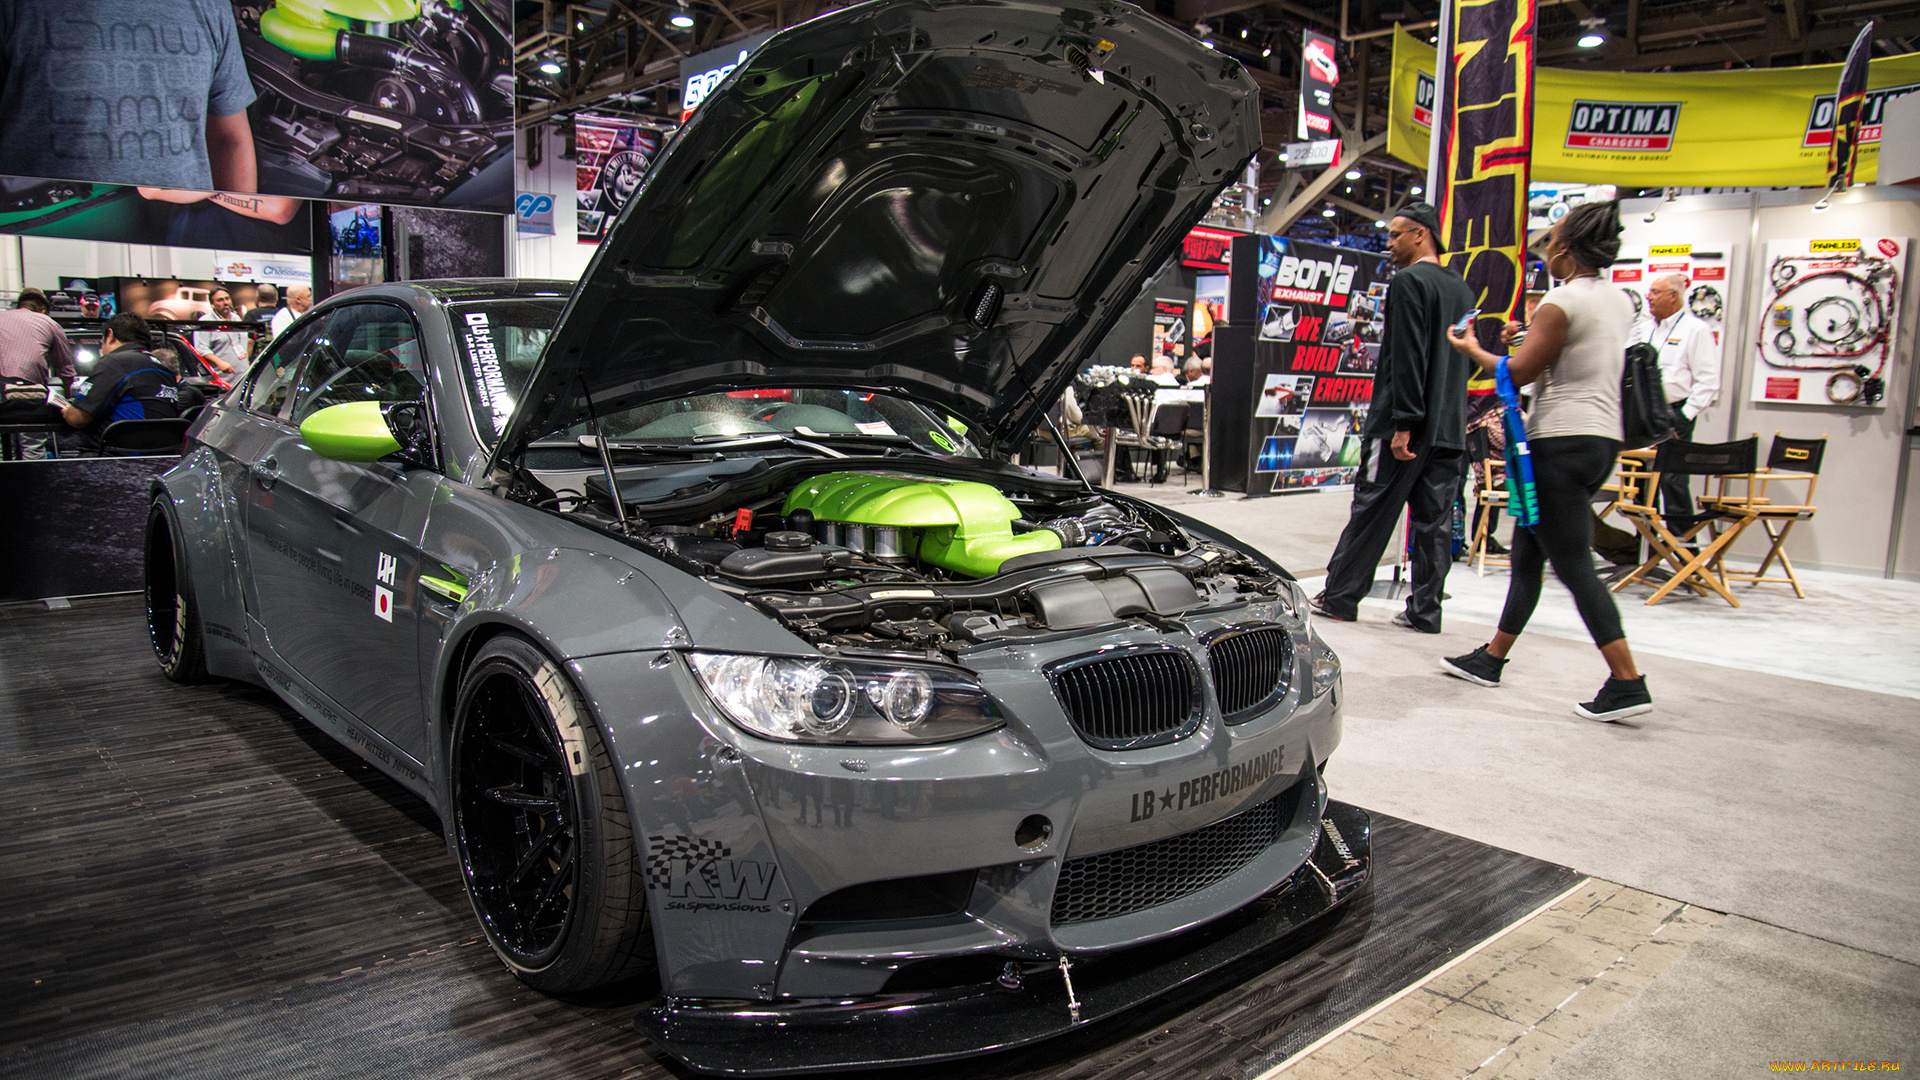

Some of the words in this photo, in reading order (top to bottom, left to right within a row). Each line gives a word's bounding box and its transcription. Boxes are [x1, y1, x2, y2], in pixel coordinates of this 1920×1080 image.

[1574, 106, 1671, 132] OPTIMA
[1589, 137, 1650, 148] CHARGERS
[1274, 288, 1324, 304] EXHAUST
[471, 325, 491, 336] LB
[1295, 316, 1323, 342] WE
[1292, 346, 1340, 373] BUILD
[469, 349, 482, 378] LIMITED
[476, 378, 491, 407] WORKS
[298, 551, 316, 574] people
[351, 581, 373, 603] peace
[346, 726, 366, 746] HEAVY
[365, 740, 391, 765] HITTERS
[1131, 789, 1155, 823] LB
[1178, 744, 1285, 811] PERFORMANCE
[667, 857, 777, 901] KW
[664, 901, 772, 914] suspensions
